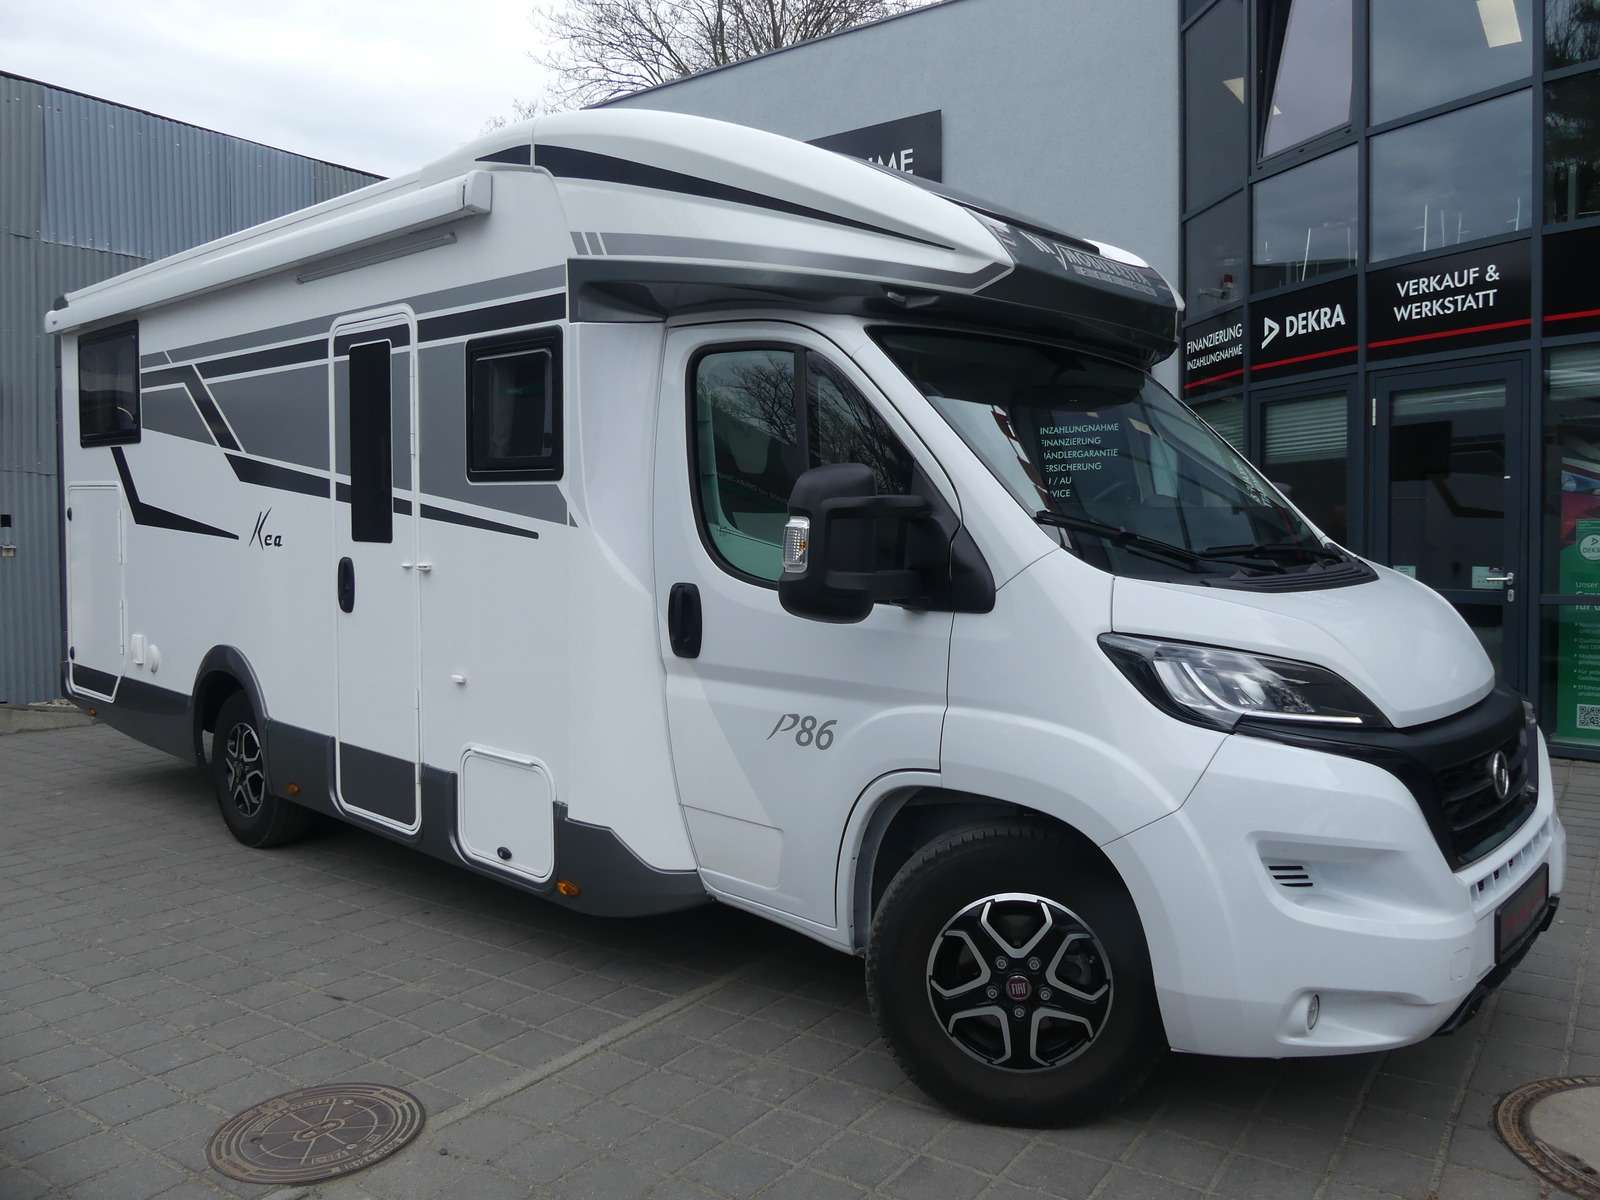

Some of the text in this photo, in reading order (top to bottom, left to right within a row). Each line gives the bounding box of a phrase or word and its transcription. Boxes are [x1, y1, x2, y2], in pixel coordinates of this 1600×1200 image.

[868, 148, 913, 175] ME
[1397, 264, 1500, 297] VERKAUF &
[1285, 304, 1346, 337] DEKRA
[1393, 289, 1498, 322] WERKSTATT
[1187, 323, 1243, 355] FINANZIERUNG
[1187, 344, 1243, 370] INZAHLUNGNAHME
[1040, 422, 1119, 435] INZAHLUNGNAHME
[1050, 489, 1071, 498] VICE
[249, 507, 283, 550] Kea
[766, 713, 838, 751] P86
